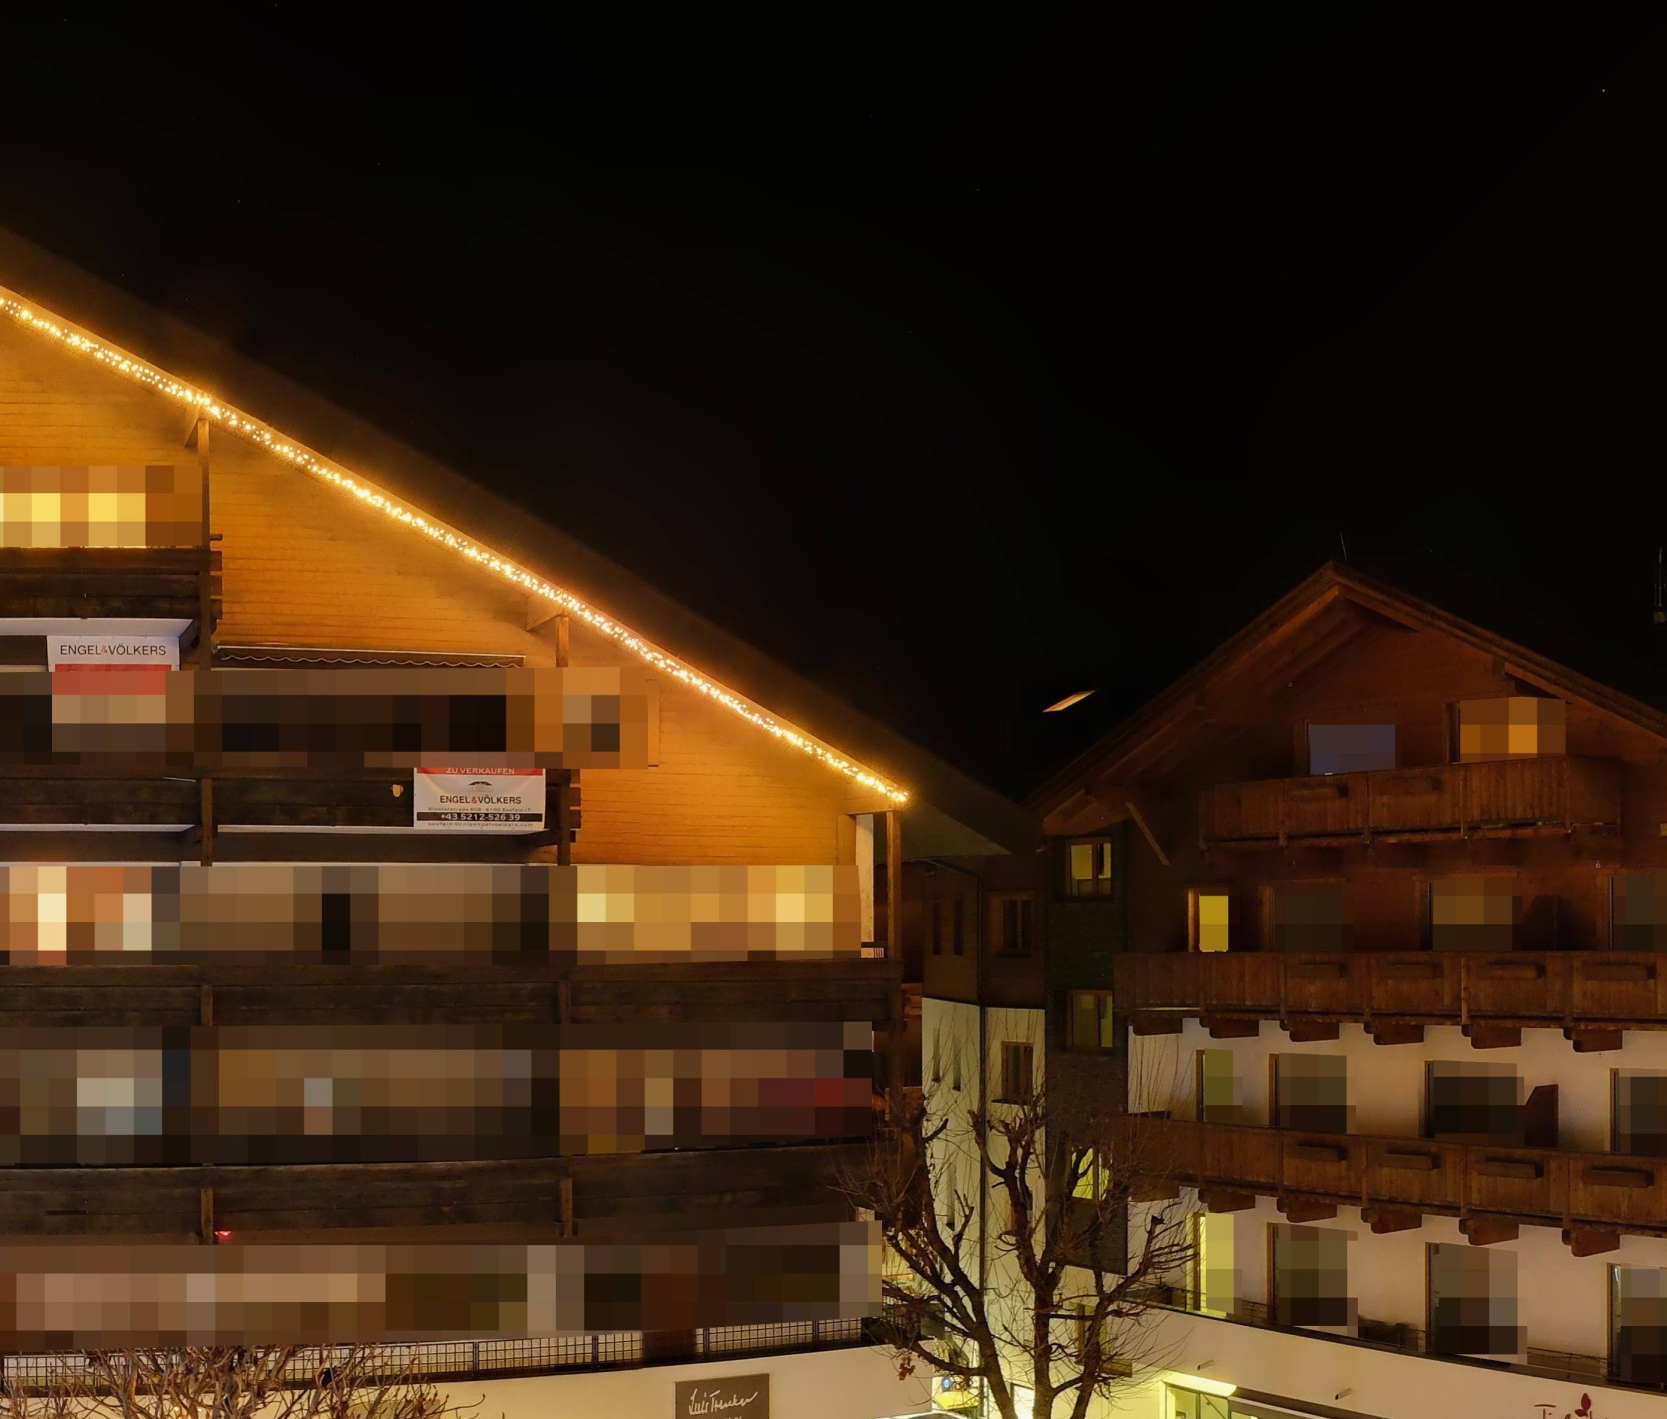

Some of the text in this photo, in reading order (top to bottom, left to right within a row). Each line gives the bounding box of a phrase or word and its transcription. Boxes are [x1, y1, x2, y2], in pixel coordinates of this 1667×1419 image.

[59, 643, 167, 656] ENGEL&VÖLKERS
[440, 813, 521, 821] +43 5212-526 39
